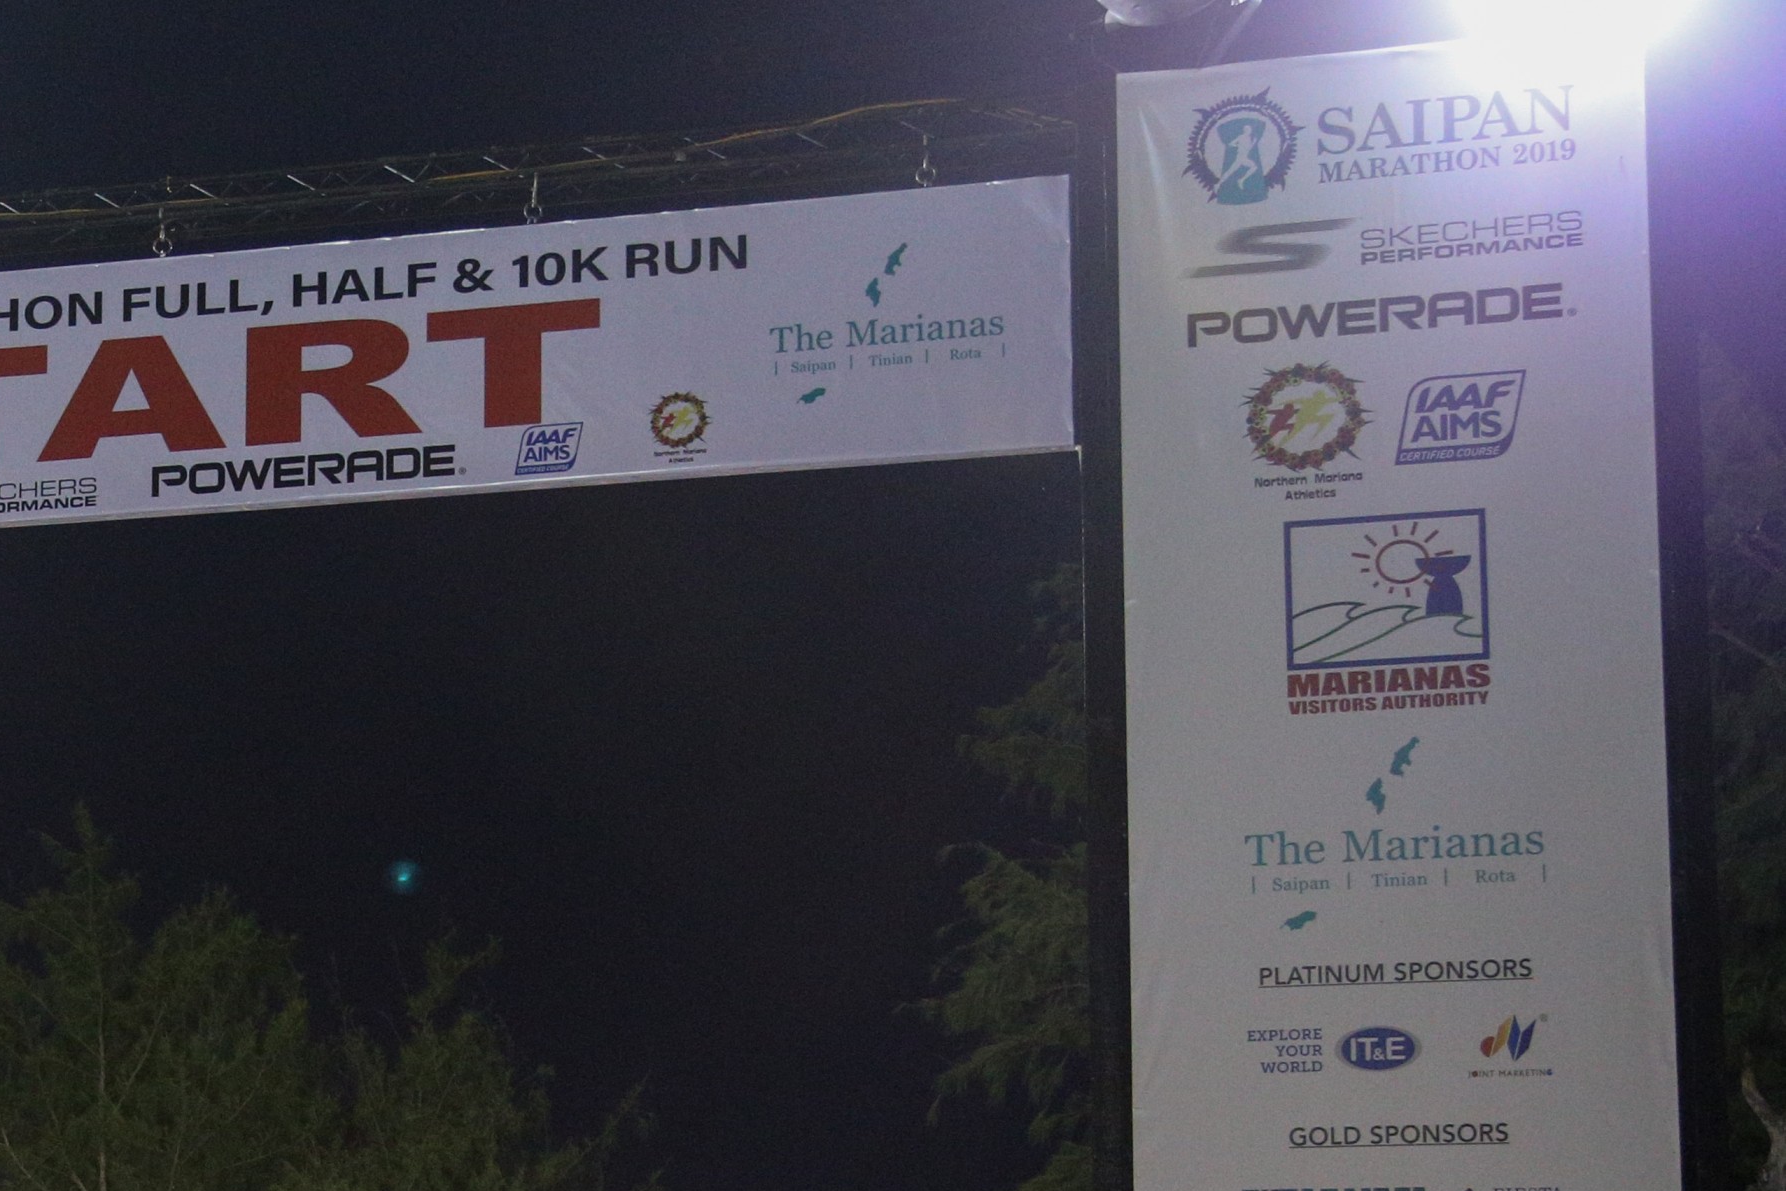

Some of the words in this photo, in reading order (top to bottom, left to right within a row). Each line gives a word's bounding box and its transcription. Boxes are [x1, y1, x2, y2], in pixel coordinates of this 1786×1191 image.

[1316, 84, 1574, 156] SAIPAN
[1317, 145, 1501, 184] MARATHON
[1513, 137, 1576, 165] 2019
[1360, 210, 1582, 250] SKECHERS
[1360, 232, 1583, 265] PERFORMANCE
[122, 278, 274, 323] FULL,
[292, 261, 438, 308] HALF
[453, 258, 494, 292] &
[511, 246, 610, 288] 10K
[625, 234, 749, 278] RUN
[1186, 282, 1564, 348] POWERADE
[769, 324, 833, 353] The
[846, 313, 1004, 347] Marianas
[790, 361, 836, 374] Saipan
[869, 352, 913, 367] Tinian
[949, 348, 982, 361] Rota
[1415, 380, 1516, 413] IAAF
[526, 427, 577, 446] IAAF
[1411, 410, 1502, 443] AIMS
[524, 445, 570, 462] AIMS
[1399, 448, 1453, 462] CERTIFIED
[1456, 445, 1501, 458] COURSE
[150, 445, 455, 498] POWERADE
[1254, 475, 1307, 488] Northern
[1314, 471, 1363, 484] Mariana
[1285, 489, 1336, 501] Athletics
[1287, 663, 1491, 698] MARIANAS
[1288, 697, 1377, 715] VISITORS
[1381, 691, 1489, 711] AUTHORITY
[1244, 830, 1326, 866] The
[1342, 825, 1544, 862] Marianas
[1272, 877, 1330, 894] Saipan
[1371, 872, 1428, 888] Tinian
[1475, 868, 1515, 883] Rota
[1259, 963, 1384, 986] PLATINUM
[1393, 958, 1533, 981] SPONSORS
[1247, 1028, 1322, 1042] EXPLORE
[1276, 1044, 1322, 1057] YOUR
[1350, 1037, 1407, 1061] IT&E
[1261, 1060, 1323, 1074] WORLD
[1289, 1126, 1361, 1147] GOLD
[1370, 1122, 1510, 1144] SPONSORS
